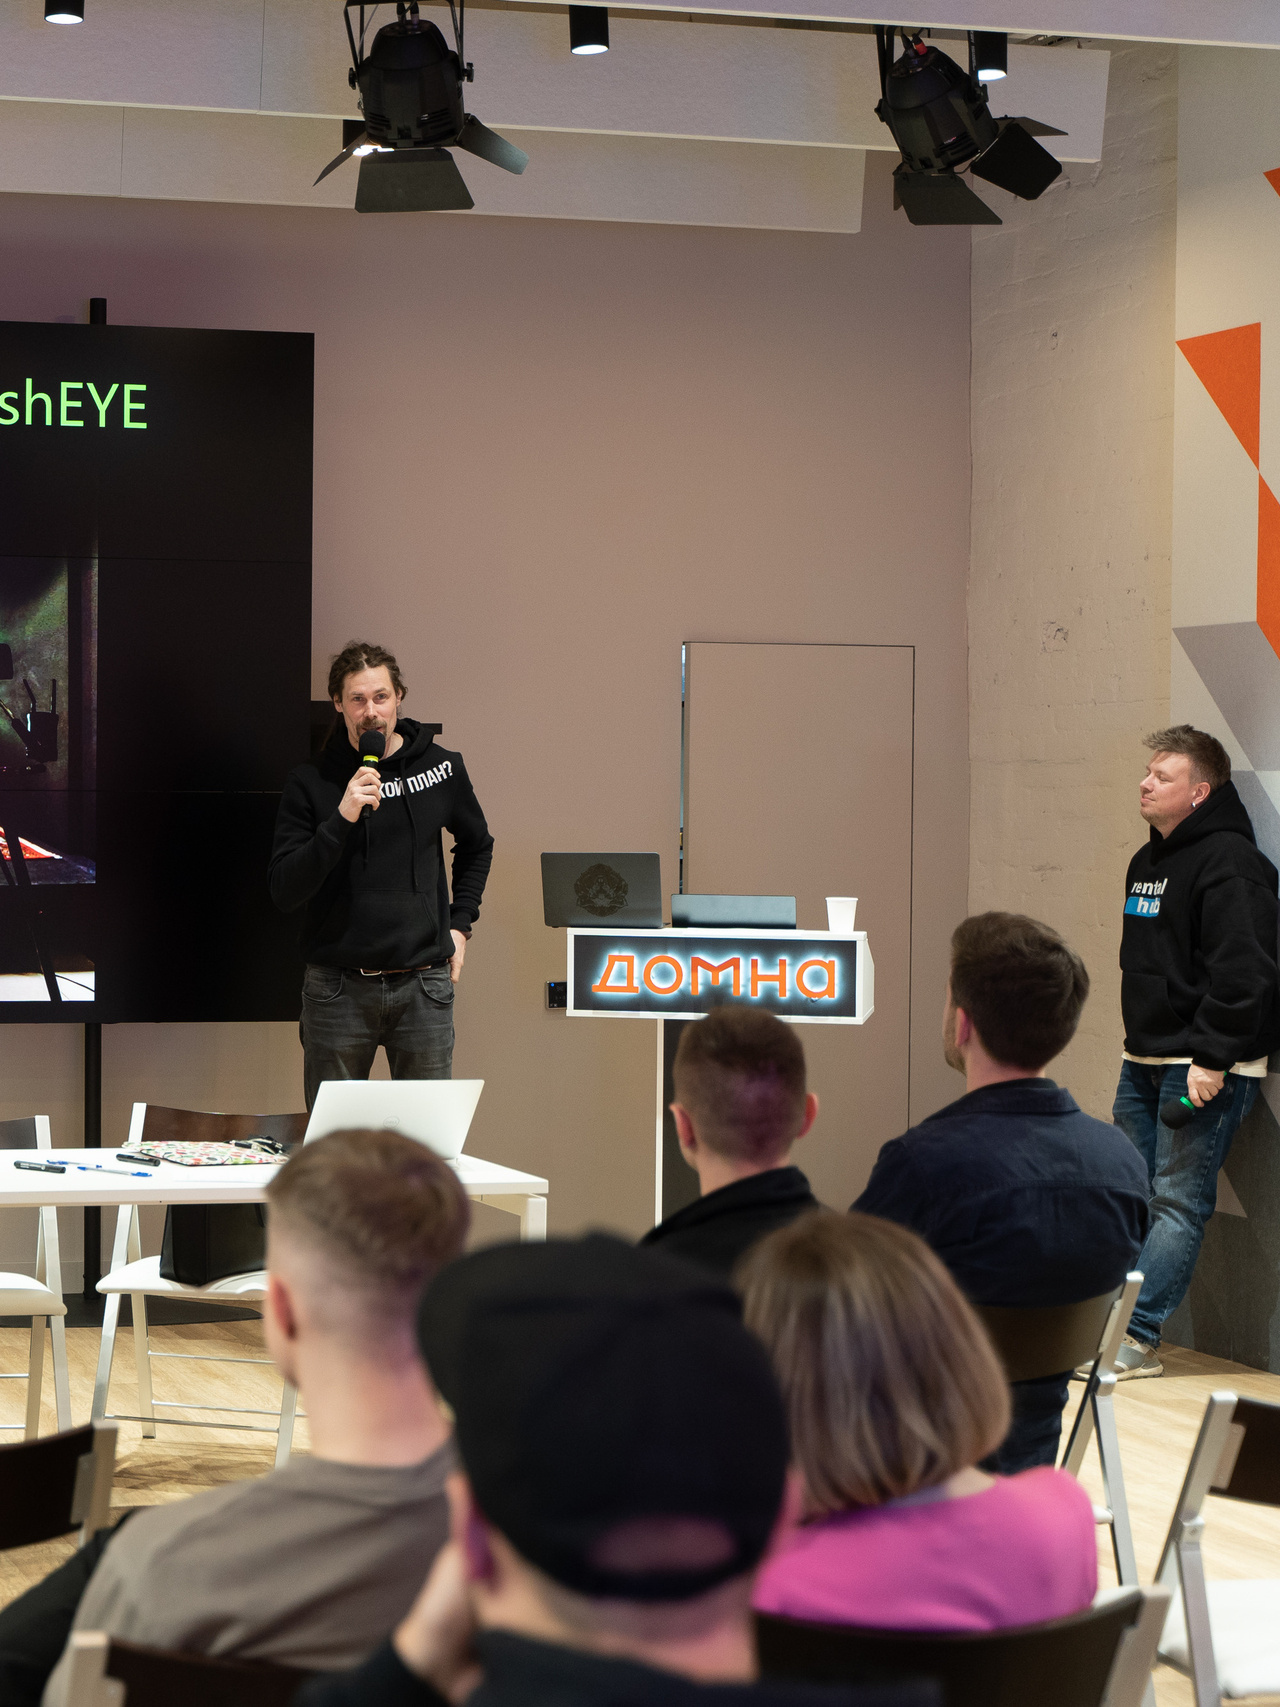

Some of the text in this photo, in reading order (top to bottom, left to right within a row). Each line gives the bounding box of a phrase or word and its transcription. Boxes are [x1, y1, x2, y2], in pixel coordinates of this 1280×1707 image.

[406, 760, 453, 793] ПЛАН?
[1130, 878, 1169, 896] rental
[1136, 896, 1161, 914] hub
